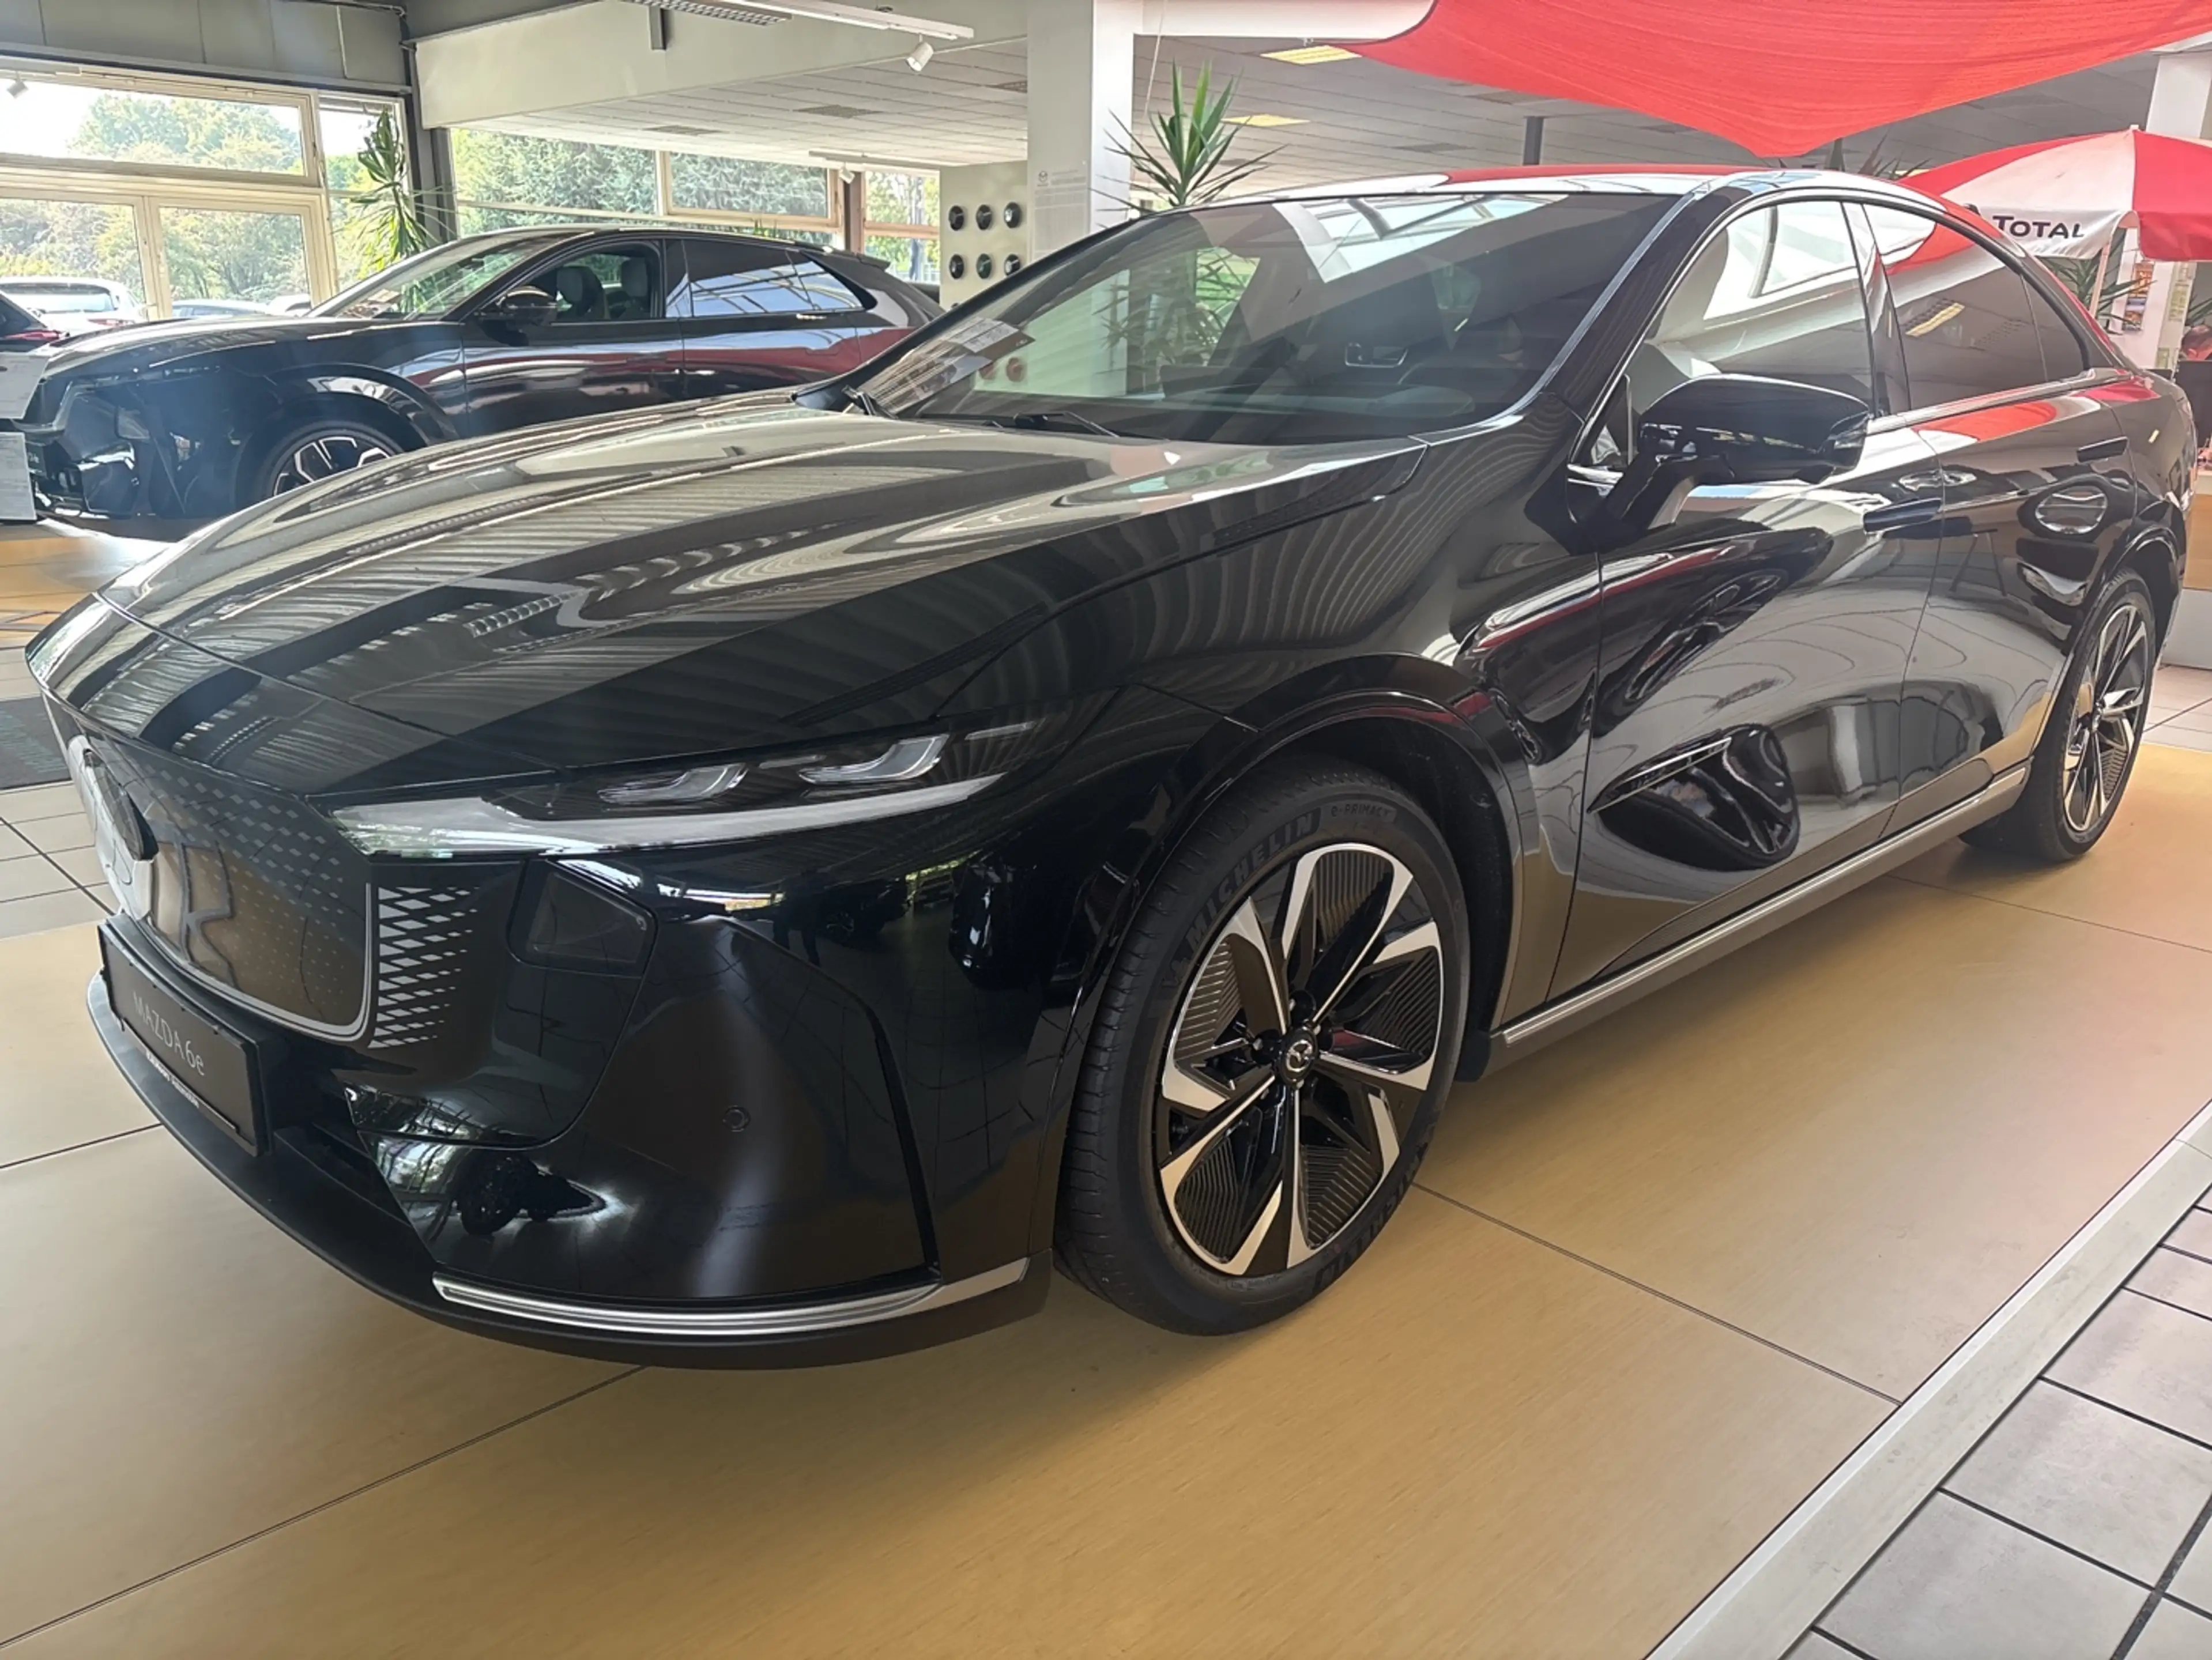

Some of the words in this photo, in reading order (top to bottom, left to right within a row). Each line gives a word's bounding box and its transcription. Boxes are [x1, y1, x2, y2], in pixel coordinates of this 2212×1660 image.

[1992, 216, 2085, 239] TOTAL
[1331, 803, 1391, 817] e-PRIMACY
[1186, 812, 1314, 950] MICHELIN
